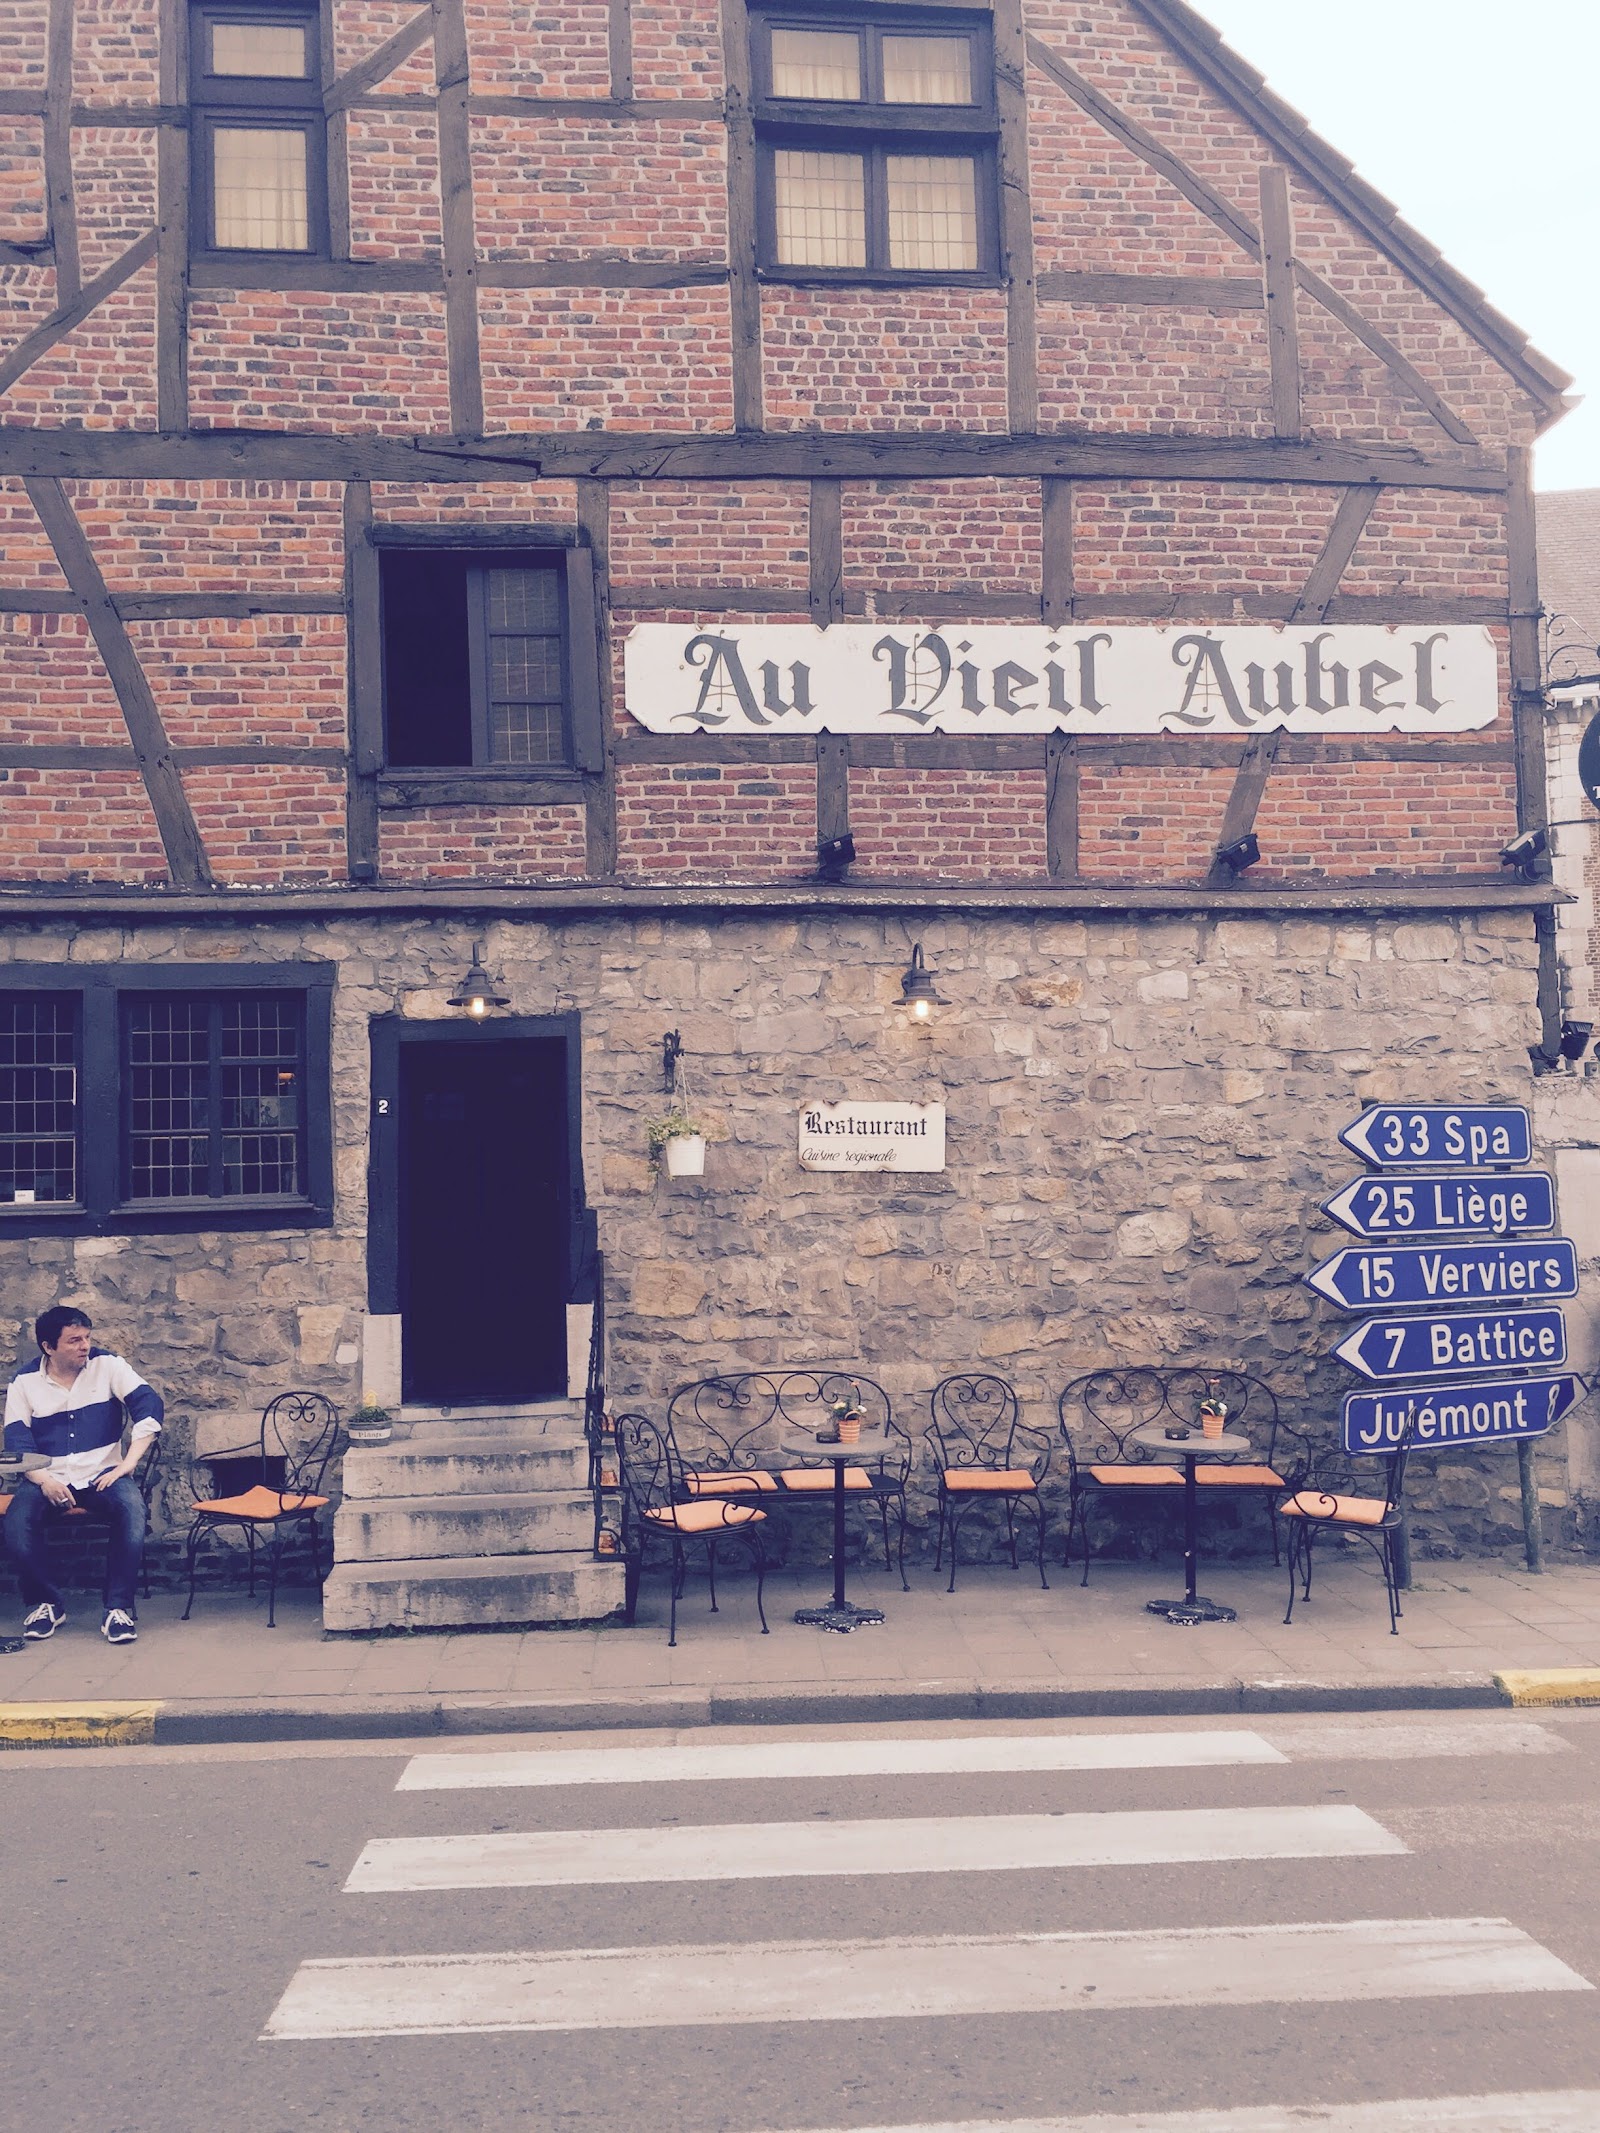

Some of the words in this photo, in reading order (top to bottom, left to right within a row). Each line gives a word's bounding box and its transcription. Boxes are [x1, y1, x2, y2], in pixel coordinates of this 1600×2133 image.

[672, 630, 816, 725] Au
[873, 633, 1112, 725] Vieil
[1160, 630, 1455, 727] Aubel
[378, 1100, 388, 1113] 2
[805, 1110, 927, 1136] Restaurant
[801, 1147, 840, 1161] Cuisine
[1383, 1114, 1429, 1157] 33
[1444, 1115, 1511, 1165] Spa
[1367, 1186, 1415, 1228] 25
[1434, 1184, 1528, 1233] Liège
[1358, 1257, 1395, 1298] 15
[1419, 1251, 1562, 1295] Verviers
[1384, 1328, 1406, 1369] 7
[1430, 1319, 1556, 1365] Battice
